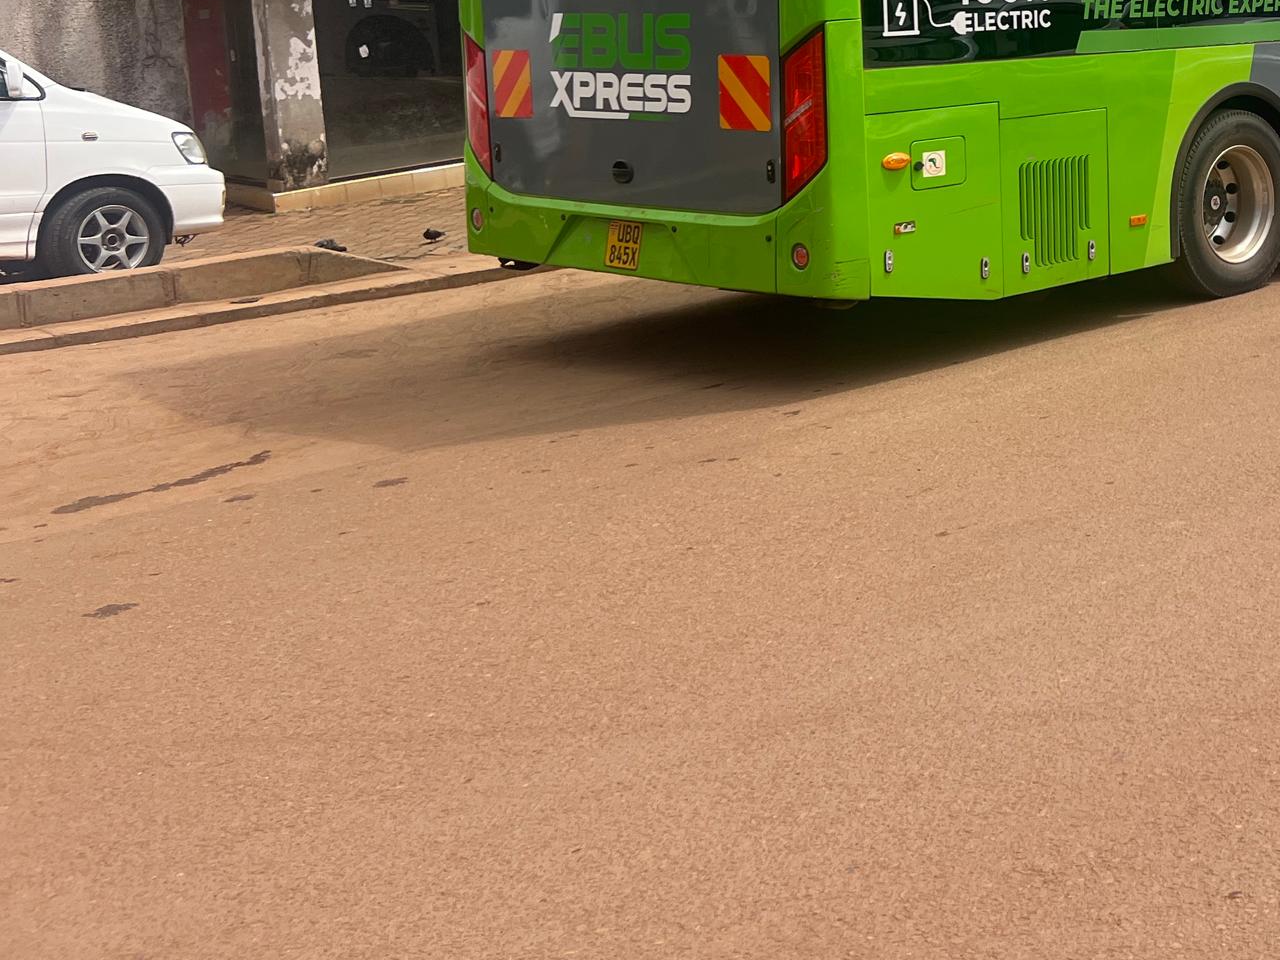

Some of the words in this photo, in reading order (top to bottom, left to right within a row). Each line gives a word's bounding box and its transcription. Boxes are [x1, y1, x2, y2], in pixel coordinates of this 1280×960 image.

[963, 10, 1052, 32] ELECTRIC
[549, 12, 691, 70] EBUS
[550, 70, 692, 119] XPRESS
[617, 223, 640, 244] UBQ
[609, 244, 638, 267] 845X
